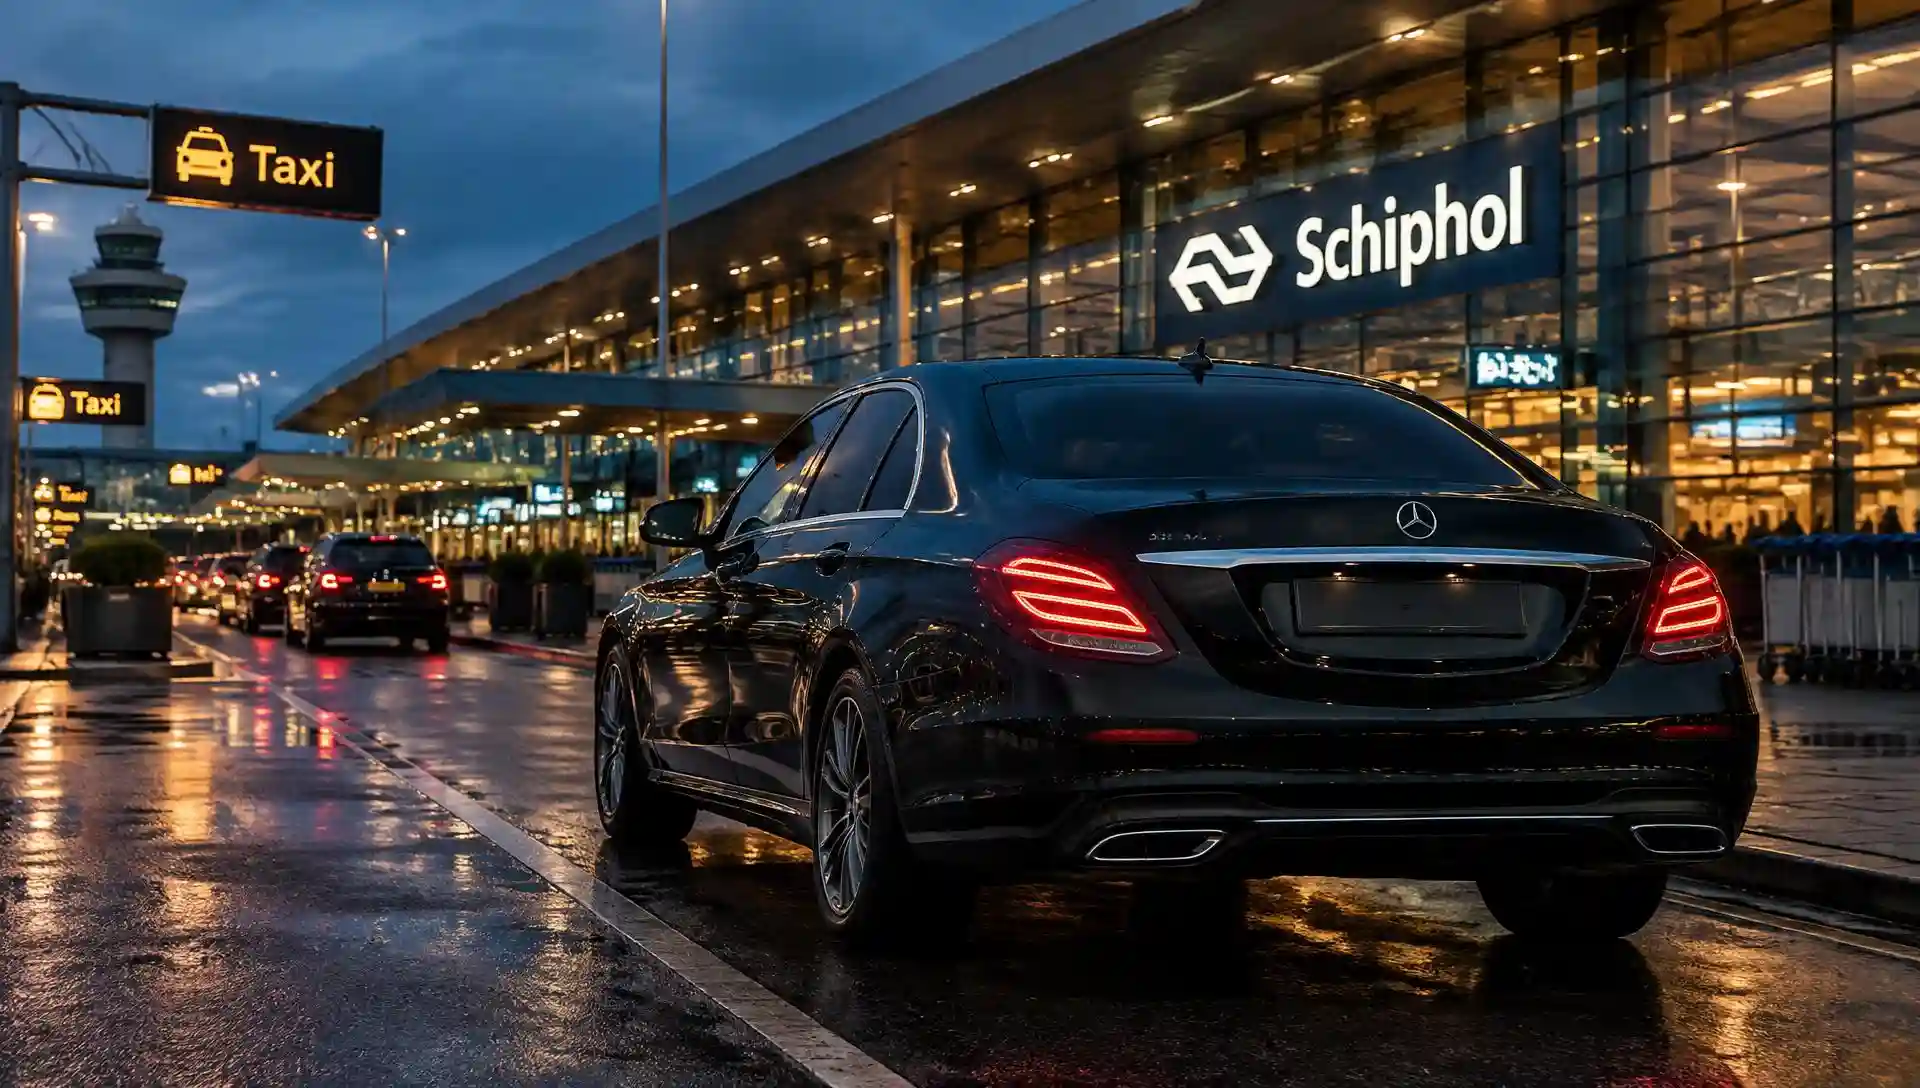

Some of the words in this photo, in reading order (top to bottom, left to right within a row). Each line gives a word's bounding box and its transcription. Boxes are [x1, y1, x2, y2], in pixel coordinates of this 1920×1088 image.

[248, 144, 335, 188] Taxi
[1296, 165, 1524, 288] Schiphol
[70, 390, 121, 416] Taxi
